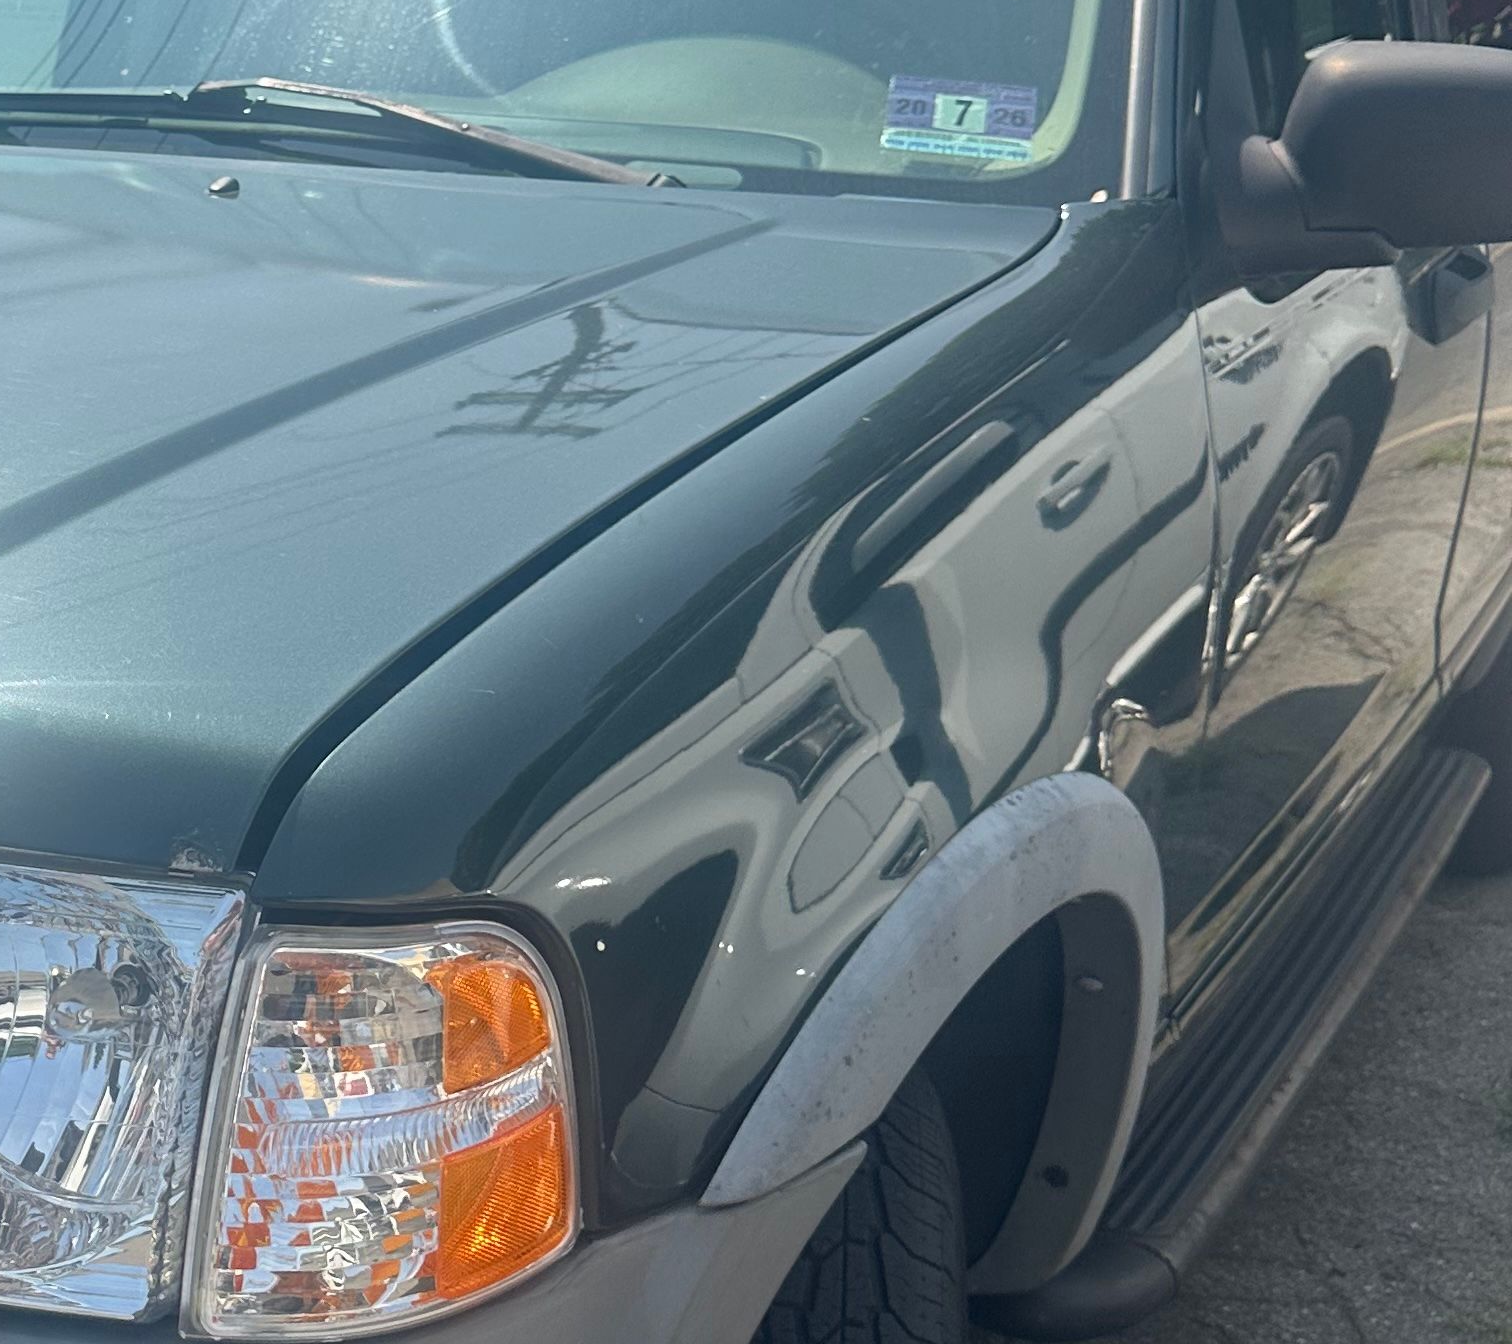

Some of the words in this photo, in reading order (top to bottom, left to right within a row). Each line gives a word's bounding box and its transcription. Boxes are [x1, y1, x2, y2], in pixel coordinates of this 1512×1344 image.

[895, 97, 927, 116] 20
[953, 99, 973, 127] 7
[994, 107, 1027, 127] 26
